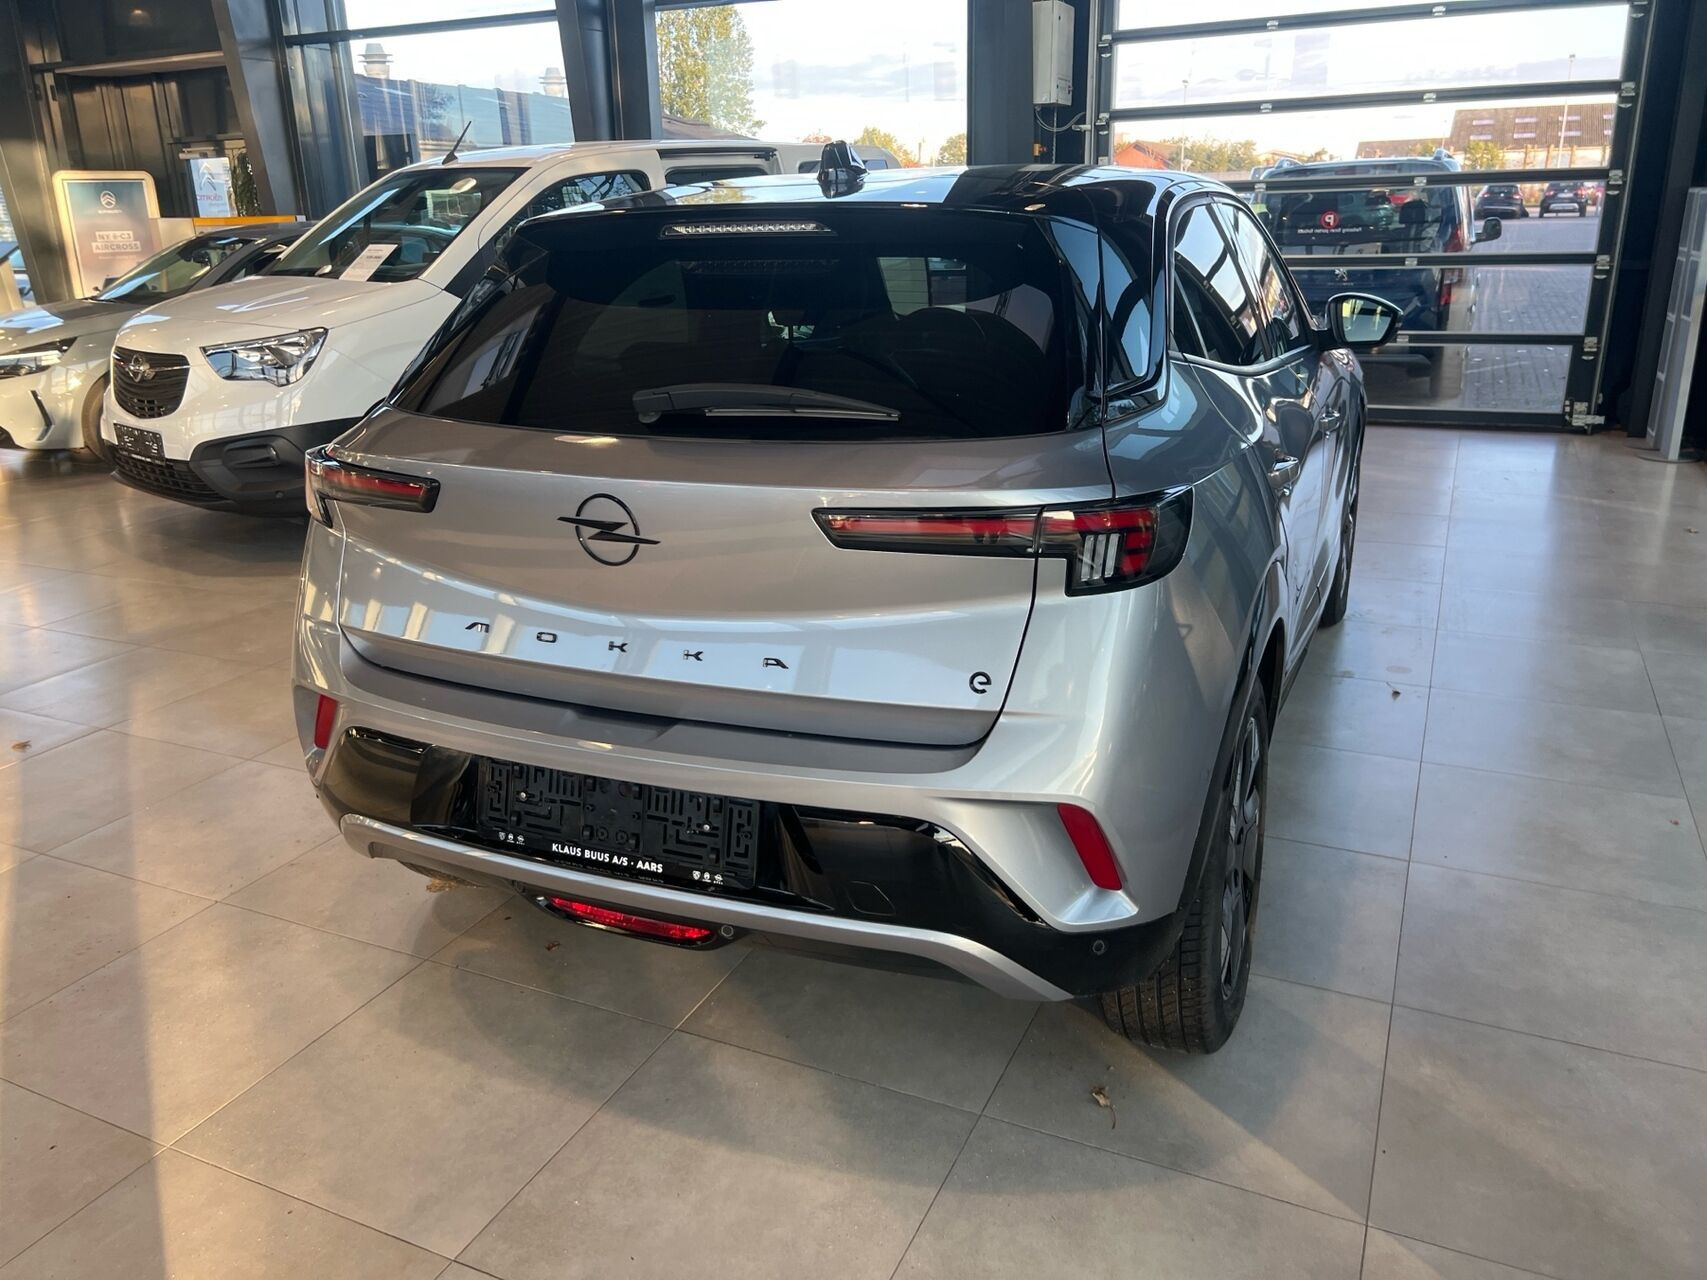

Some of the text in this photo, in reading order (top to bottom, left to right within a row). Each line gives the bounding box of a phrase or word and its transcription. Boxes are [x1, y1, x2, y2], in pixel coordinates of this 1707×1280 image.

[95, 242, 139, 251] AIRCROSS
[551, 843, 663, 873] KLAUS BUUS A/S AARS
